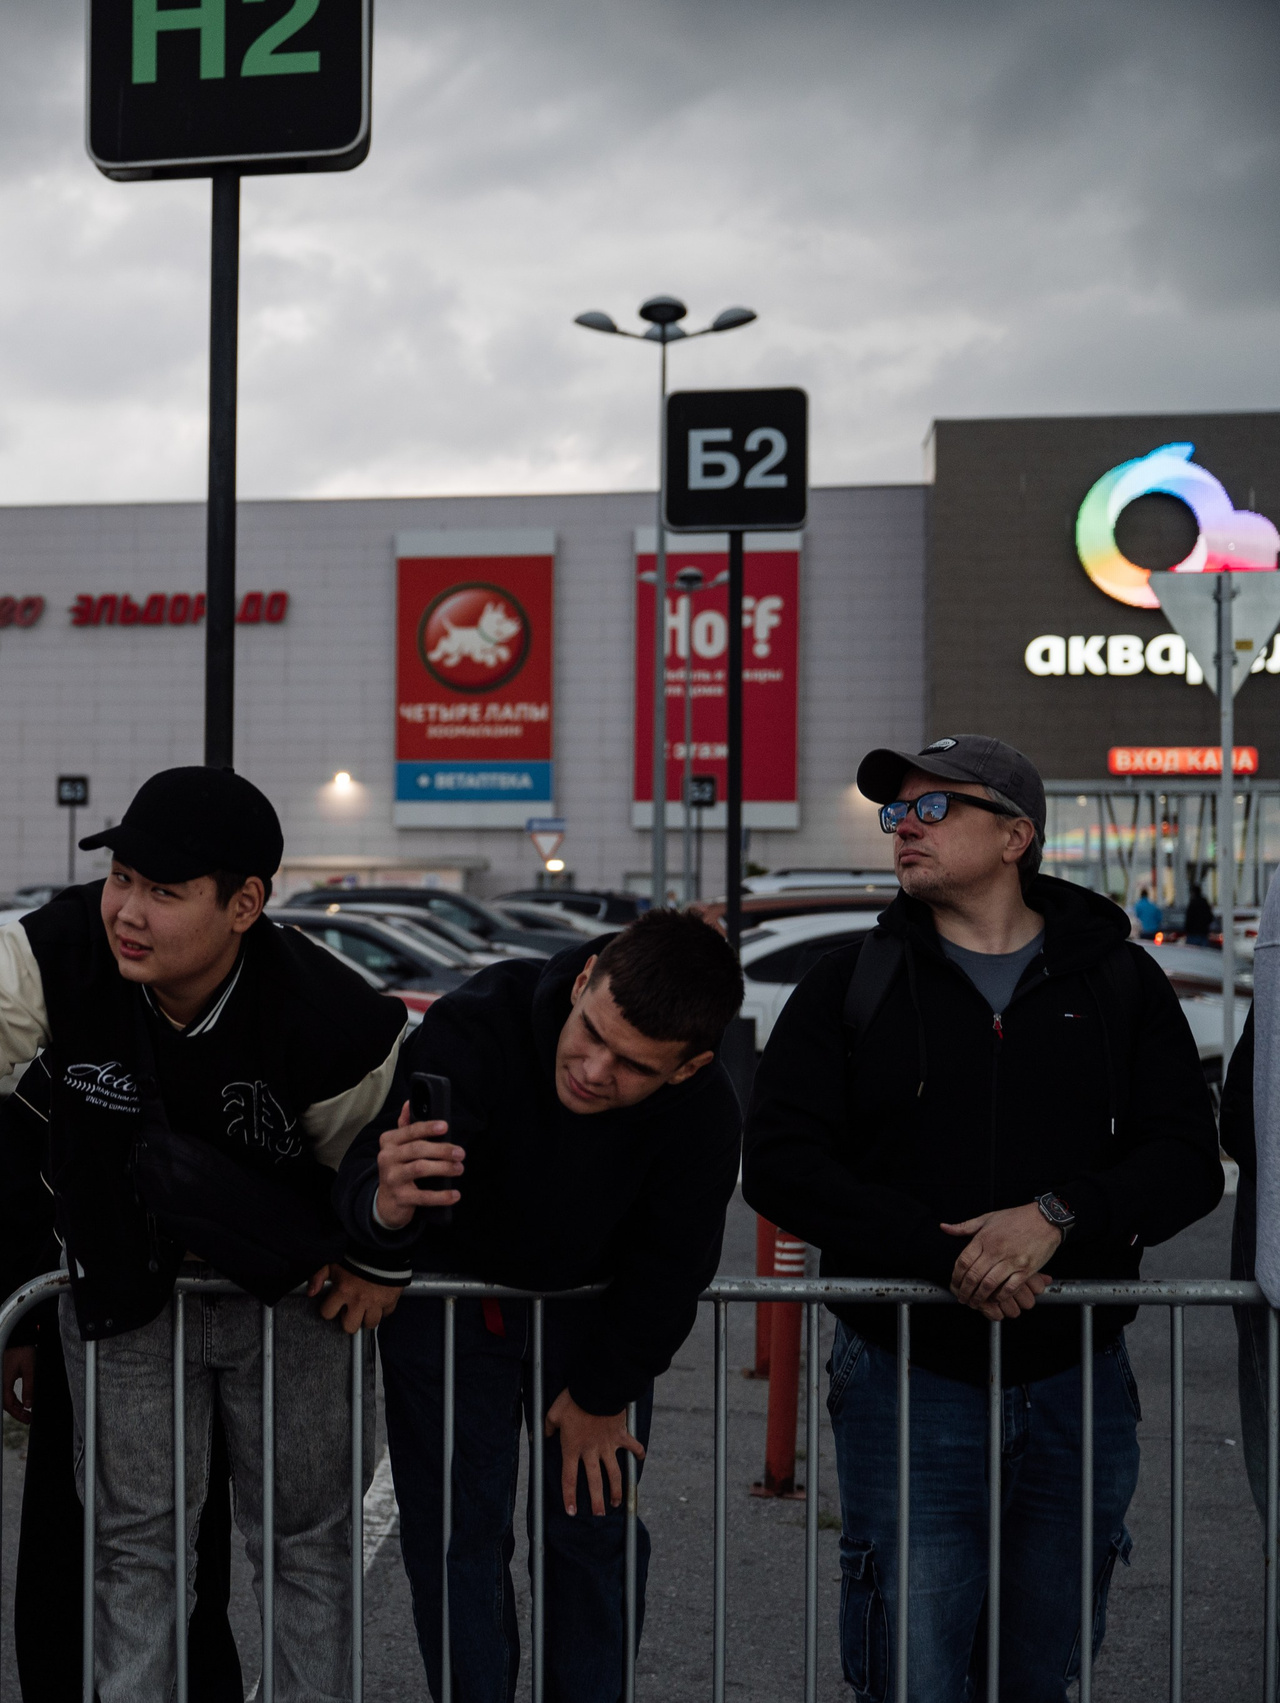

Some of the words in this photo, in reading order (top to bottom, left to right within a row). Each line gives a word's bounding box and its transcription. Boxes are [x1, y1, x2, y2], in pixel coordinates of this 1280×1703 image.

[686, 426, 789, 492] Б2
[69, 591, 289, 626] ЭЛЬДОРДО
[399, 701, 482, 723] ЧЕТЫРЕ
[484, 701, 550, 722] ЛАПЫ
[1115, 748, 1180, 773] ВХОД
[1187, 748, 1254, 772] КАА
[433, 770, 535, 791] ВЕТАПТЕКА
